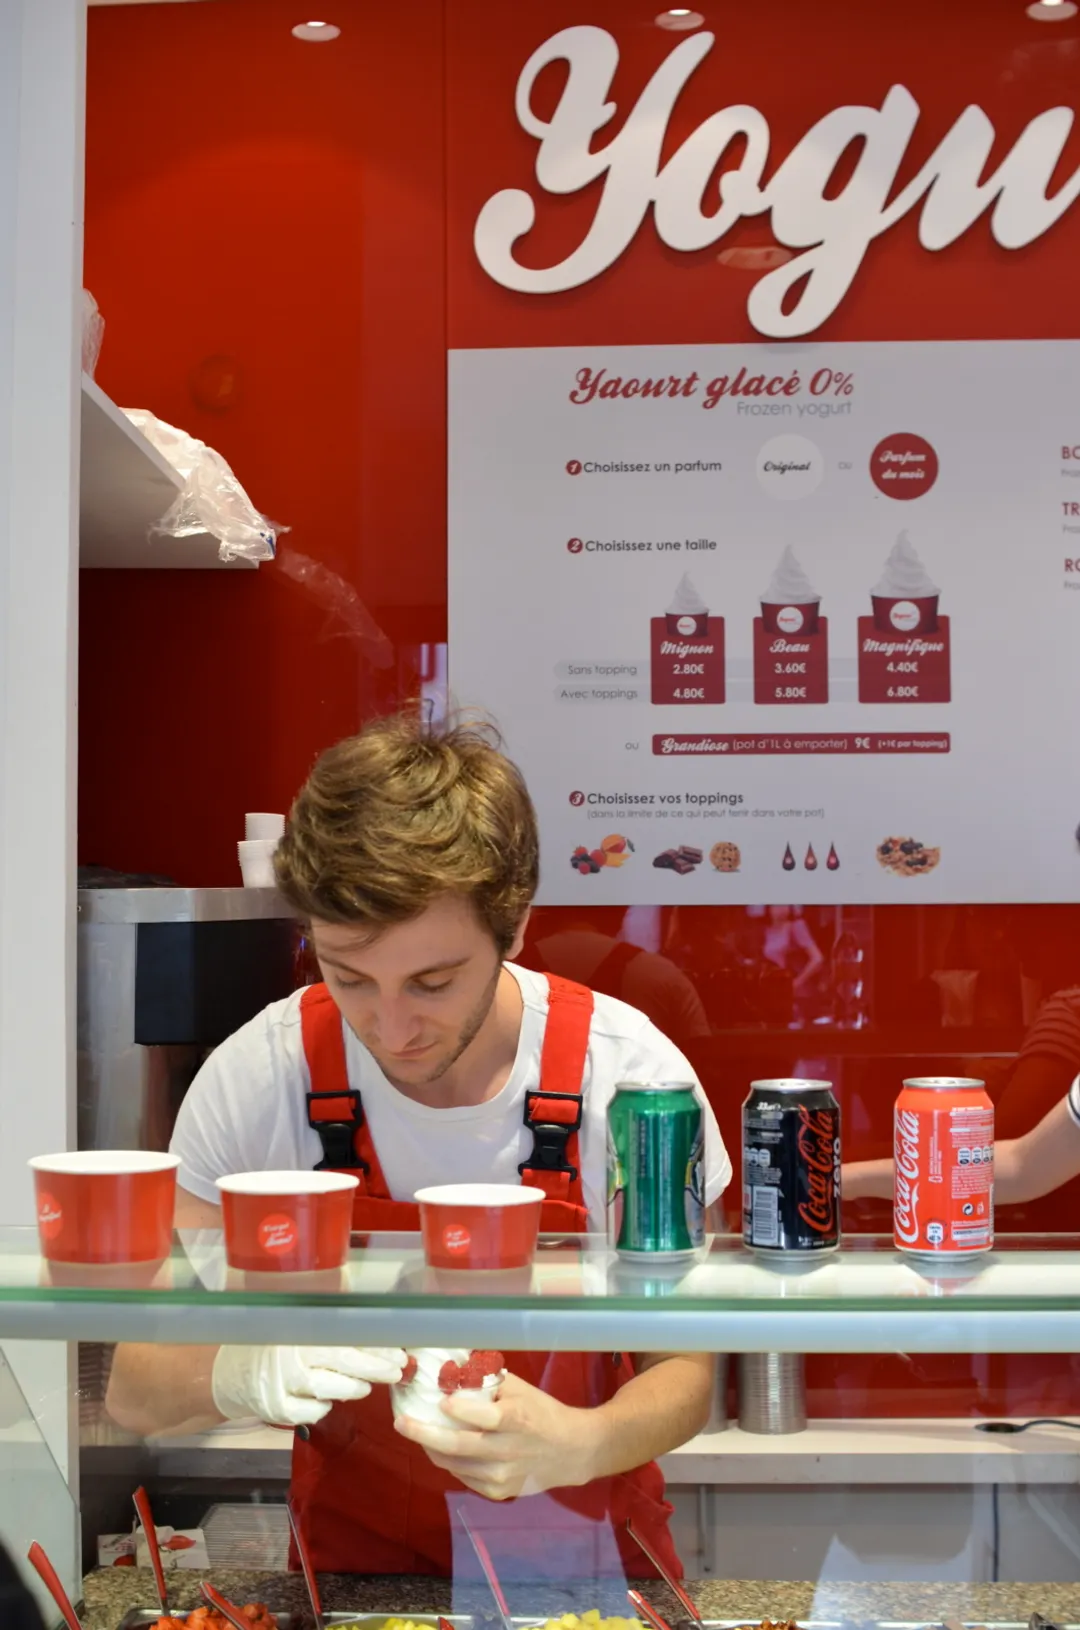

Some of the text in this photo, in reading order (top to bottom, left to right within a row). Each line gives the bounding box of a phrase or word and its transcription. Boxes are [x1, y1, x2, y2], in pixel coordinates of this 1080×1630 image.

[569, 366, 854, 409] Yaourt glacé 0%
[736, 400, 852, 419] Frozen yogurt
[583, 461, 651, 473] Choisissez
[654, 462, 671, 472] un
[674, 460, 722, 474] parfum
[763, 460, 811, 475] Original
[899, 468, 925, 480] mois
[585, 539, 652, 552] Choisissez
[656, 542, 682, 551] une
[685, 539, 718, 551] taille
[660, 641, 714, 659] Mignon
[769, 638, 810, 653] Beau
[863, 638, 944, 657] Magnifique
[568, 664, 638, 677] Sans topping
[673, 663, 705, 675] 2.80€
[774, 662, 807, 674] 3.60€
[886, 661, 919, 673] 4.40€
[560, 688, 638, 701] Avec toppings
[673, 687, 705, 699] 4.80€
[775, 686, 807, 698] 5.80€
[887, 686, 919, 698] 6.80€
[625, 741, 639, 750] ou
[661, 737, 729, 754] Grandiose
[732, 738, 756, 752] (pot
[783, 738, 792, 749] à
[794, 738, 848, 751] emporter)
[854, 736, 870, 749] 9€
[587, 793, 655, 805] Choisissez
[659, 795, 682, 804] vos
[685, 792, 744, 806] toppings
[670, 810, 684, 819] ce
